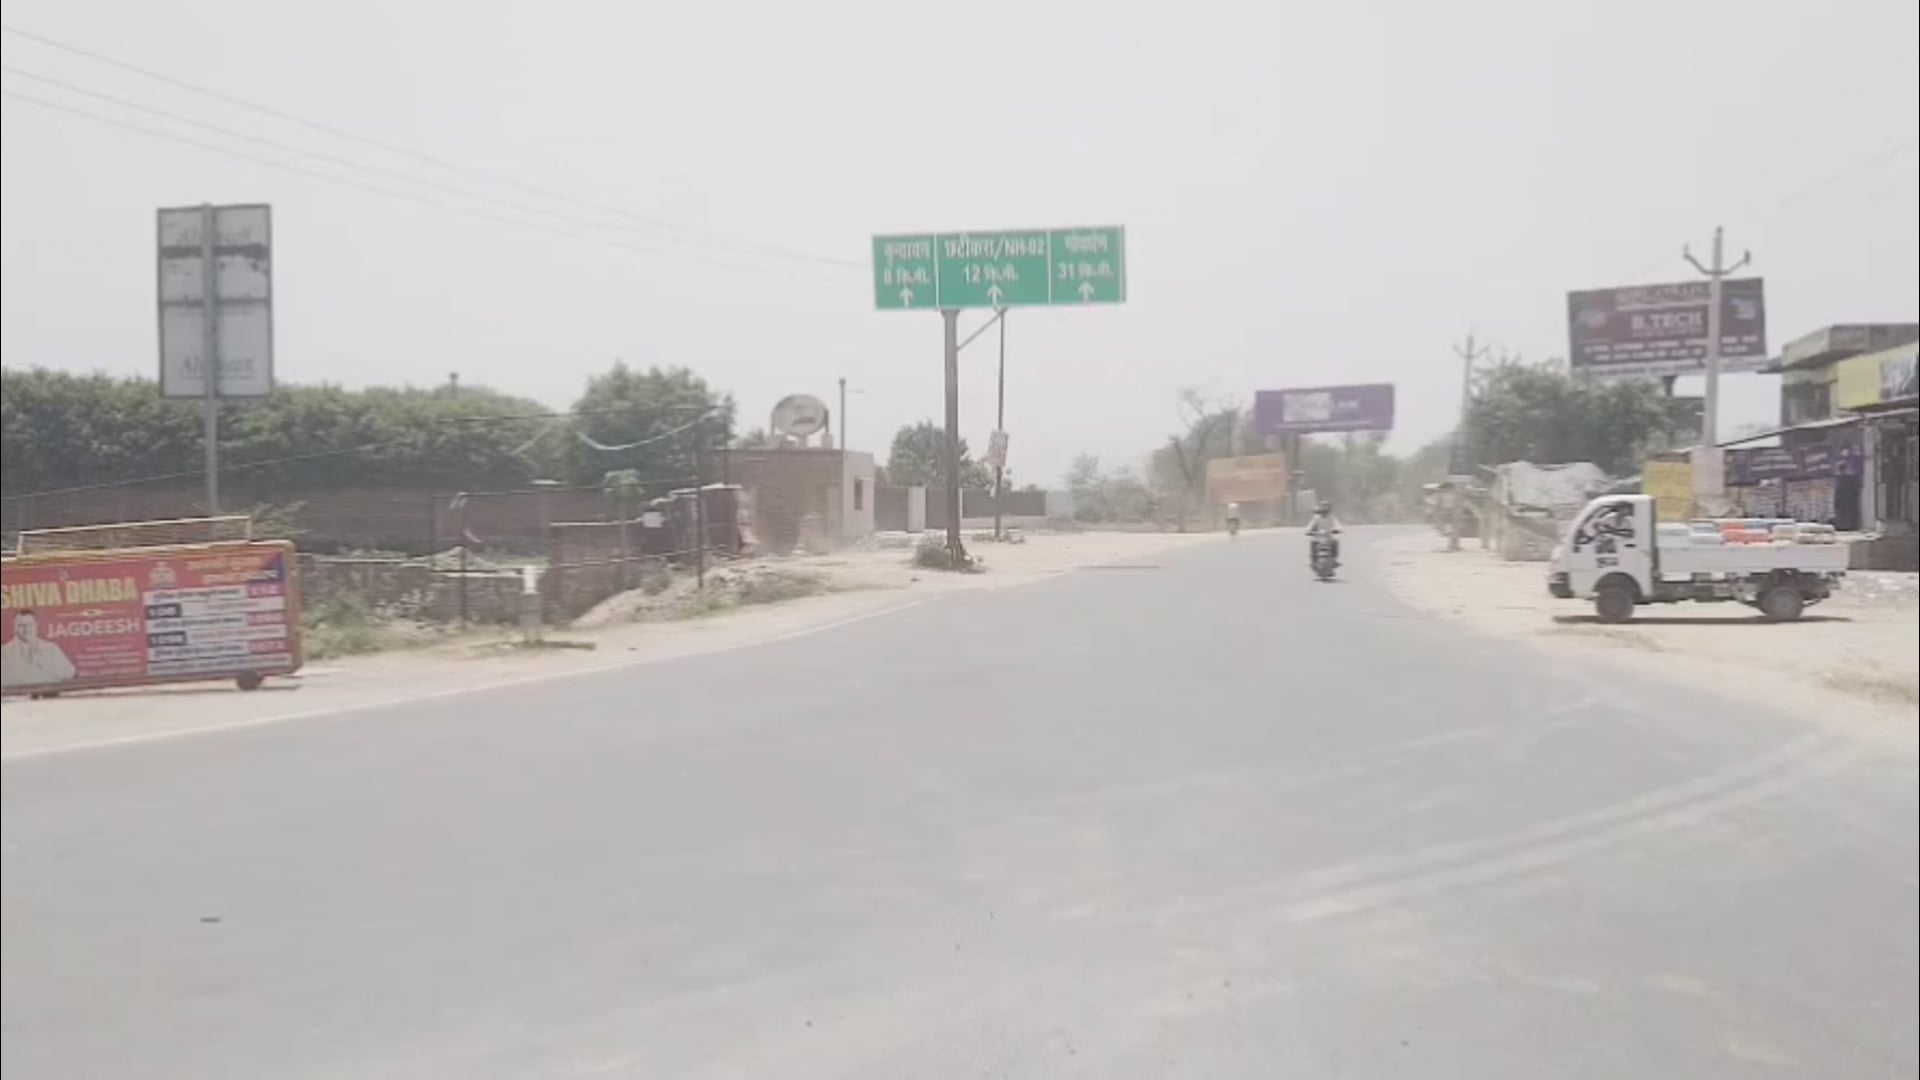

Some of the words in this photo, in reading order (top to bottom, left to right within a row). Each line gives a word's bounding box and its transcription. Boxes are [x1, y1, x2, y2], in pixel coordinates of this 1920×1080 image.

[962, 263, 980, 283] 12
[1057, 261, 1073, 280] 31
[1, 581, 62, 609] SHIVA
[66, 577, 138, 605] DHABA
[47, 617, 141, 639] JAGDEESH
